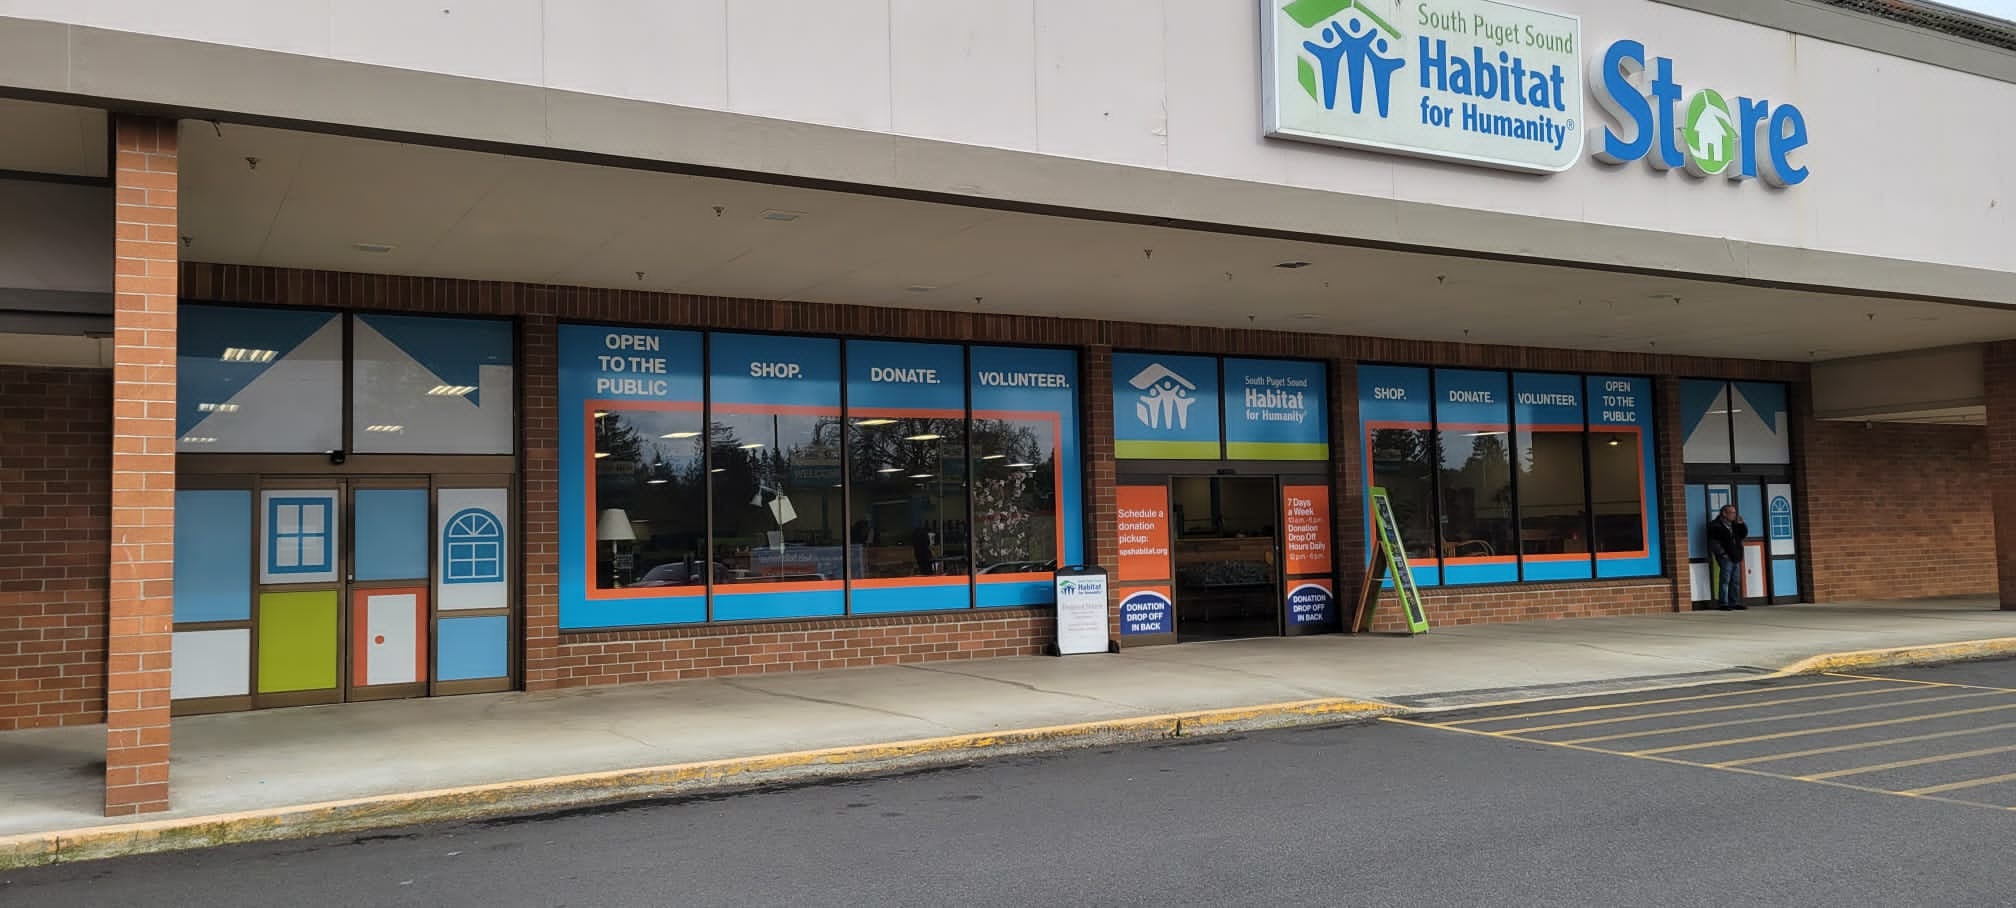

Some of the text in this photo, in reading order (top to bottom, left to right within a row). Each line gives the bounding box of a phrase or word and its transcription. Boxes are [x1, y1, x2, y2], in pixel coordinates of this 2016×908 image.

[1418, 3, 1573, 54] South Puget Sound
[1419, 36, 1565, 111] Habitat
[1421, 96, 1453, 128] for
[1601, 39, 1810, 186] Store
[605, 333, 660, 351] OPEN
[598, 355, 667, 374] TO THE
[749, 361, 803, 379] SHOP.
[870, 367, 941, 385] DONATE.
[977, 371, 1070, 389] VOLUNTEER.
[1245, 376, 1308, 388] South Puget Sound
[597, 378, 668, 396] PUBLIC
[1605, 381, 1631, 392] OPEN
[1245, 388, 1304, 409] Habitat
[1374, 387, 1407, 400] SHOP.
[1449, 390, 1494, 403] DONATE.
[1518, 393, 1577, 406] VOLUNTEER.
[1602, 395, 1635, 407] TO THE
[1246, 410, 1304, 424] for Humanity
[1602, 411, 1636, 422] PUBLIC
[1288, 498, 1311, 508] 7 Days
[1118, 509, 1157, 518] Schedule
[1294, 508, 1314, 516] Week
[1119, 521, 1155, 530] donation
[1288, 533, 1316, 542] Drop Off
[1288, 542, 1326, 552] Hours Daily
[1293, 595, 1326, 603] DONATION
[1126, 602, 1165, 611] DONATION
[1293, 603, 1325, 612] DROP OFF
[1126, 612, 1164, 622] DROP OFF
[1297, 613, 1324, 622] IN BACK
[1131, 622, 1161, 632] IN BACK
